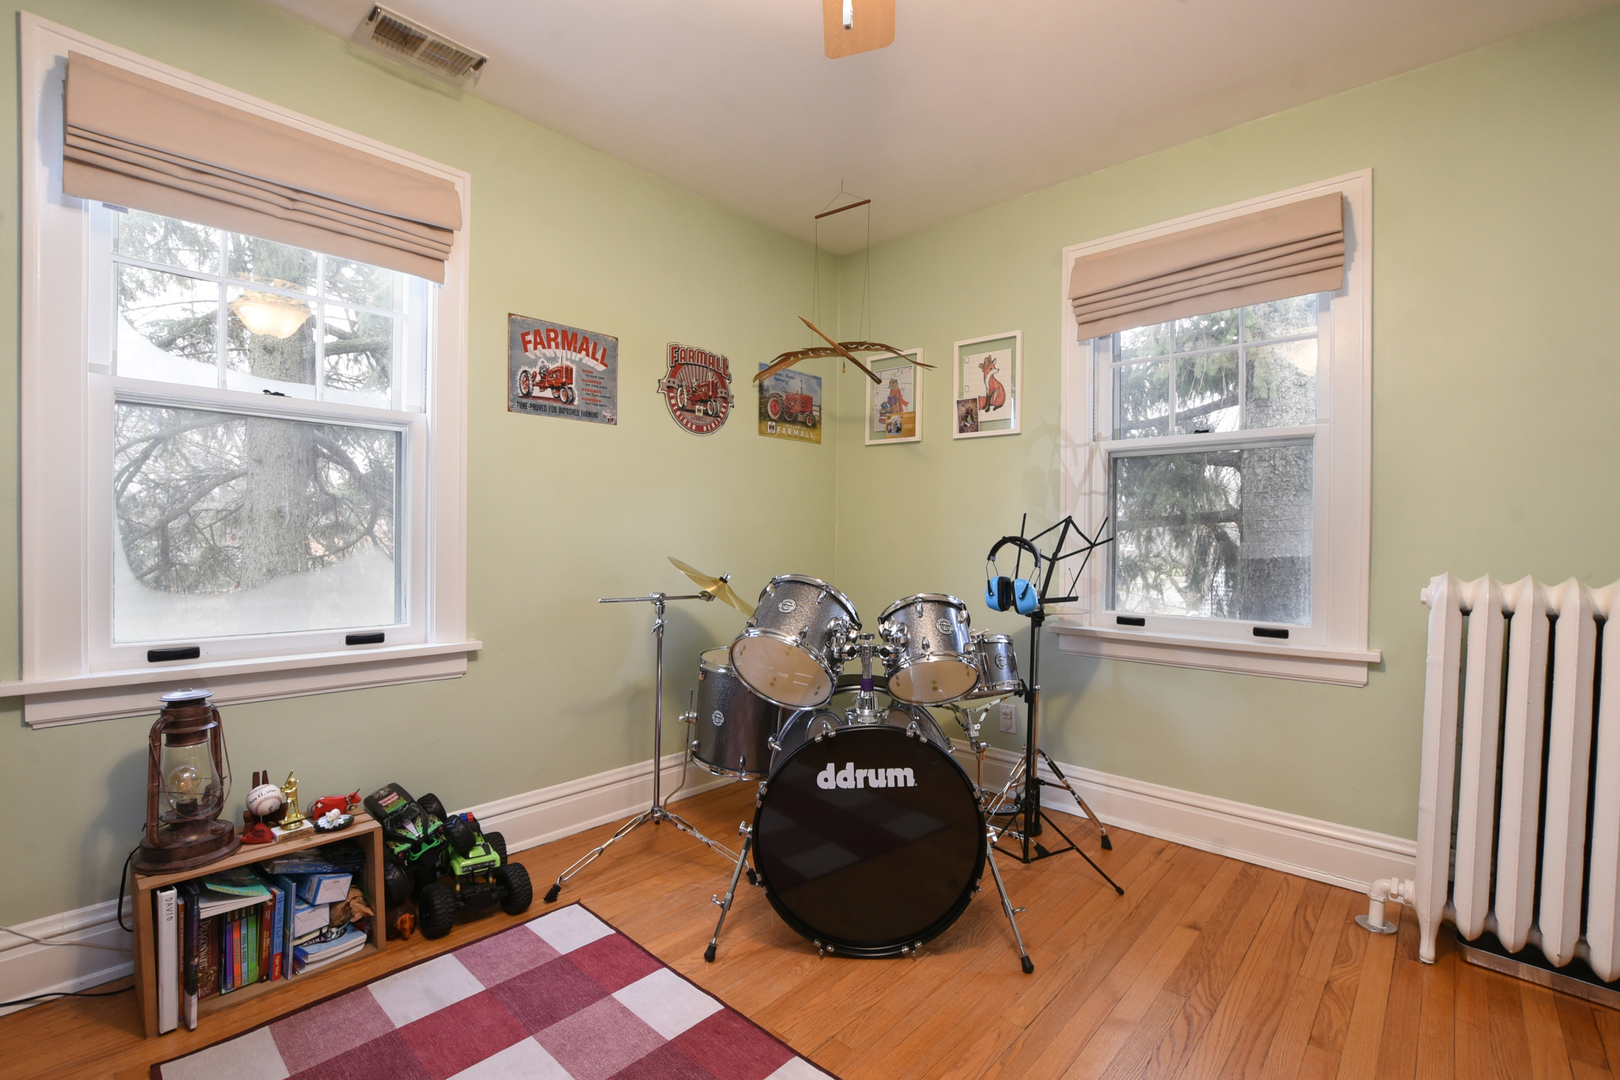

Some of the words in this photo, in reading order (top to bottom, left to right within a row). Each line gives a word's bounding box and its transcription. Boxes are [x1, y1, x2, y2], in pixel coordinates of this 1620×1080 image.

[520, 328, 608, 368] FARMALL
[669, 345, 730, 379] FARMALL
[558, 407, 580, 416] IMPROVED
[669, 391, 697, 431] AMERICAN
[776, 426, 815, 439] FARMALL
[816, 762, 916, 790] ddrum
[164, 896, 174, 922] DAVID
